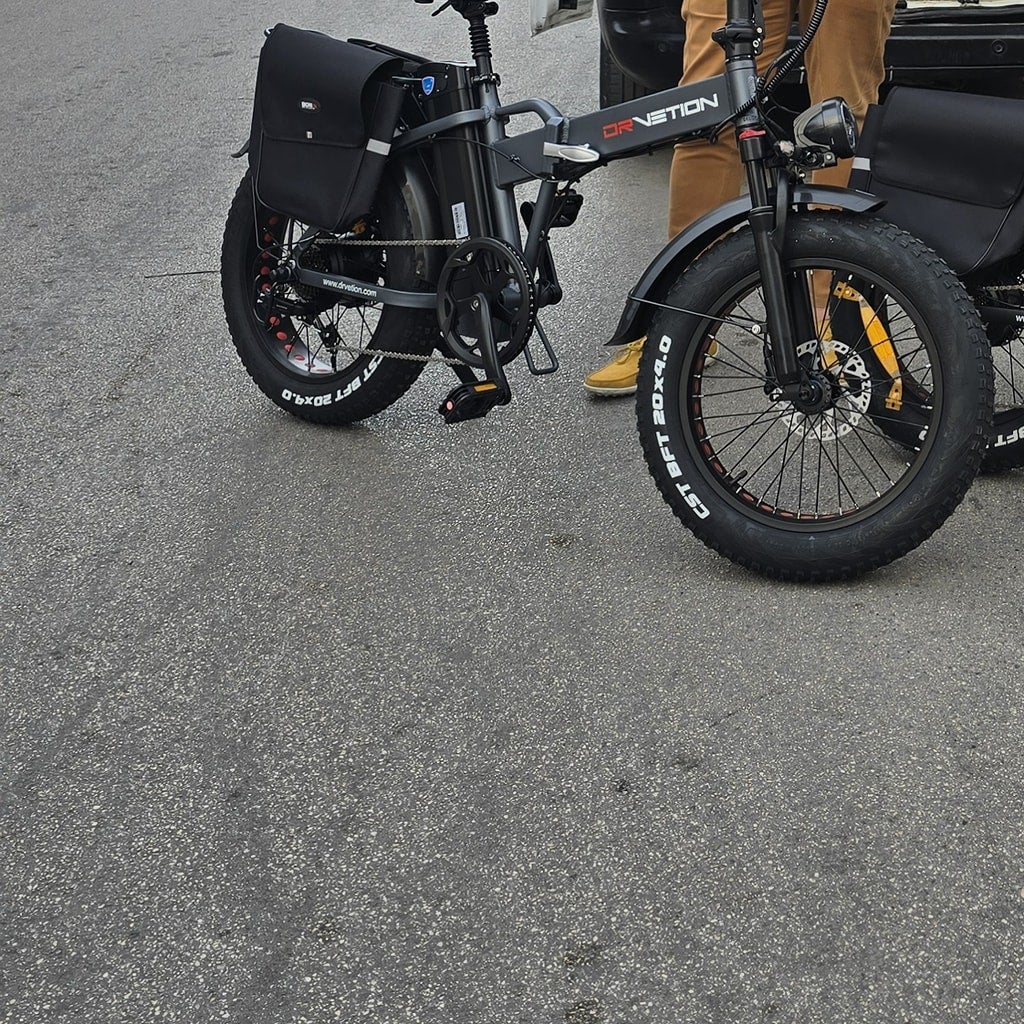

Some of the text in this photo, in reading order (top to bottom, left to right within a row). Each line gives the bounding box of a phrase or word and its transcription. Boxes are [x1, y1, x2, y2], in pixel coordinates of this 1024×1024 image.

[322, 277, 377, 298] www.drvetion.com
[363, 353, 384, 382] CST
[334, 376, 362, 402] BFT
[655, 431, 683, 479] BFT
[675, 482, 711, 520] CST
